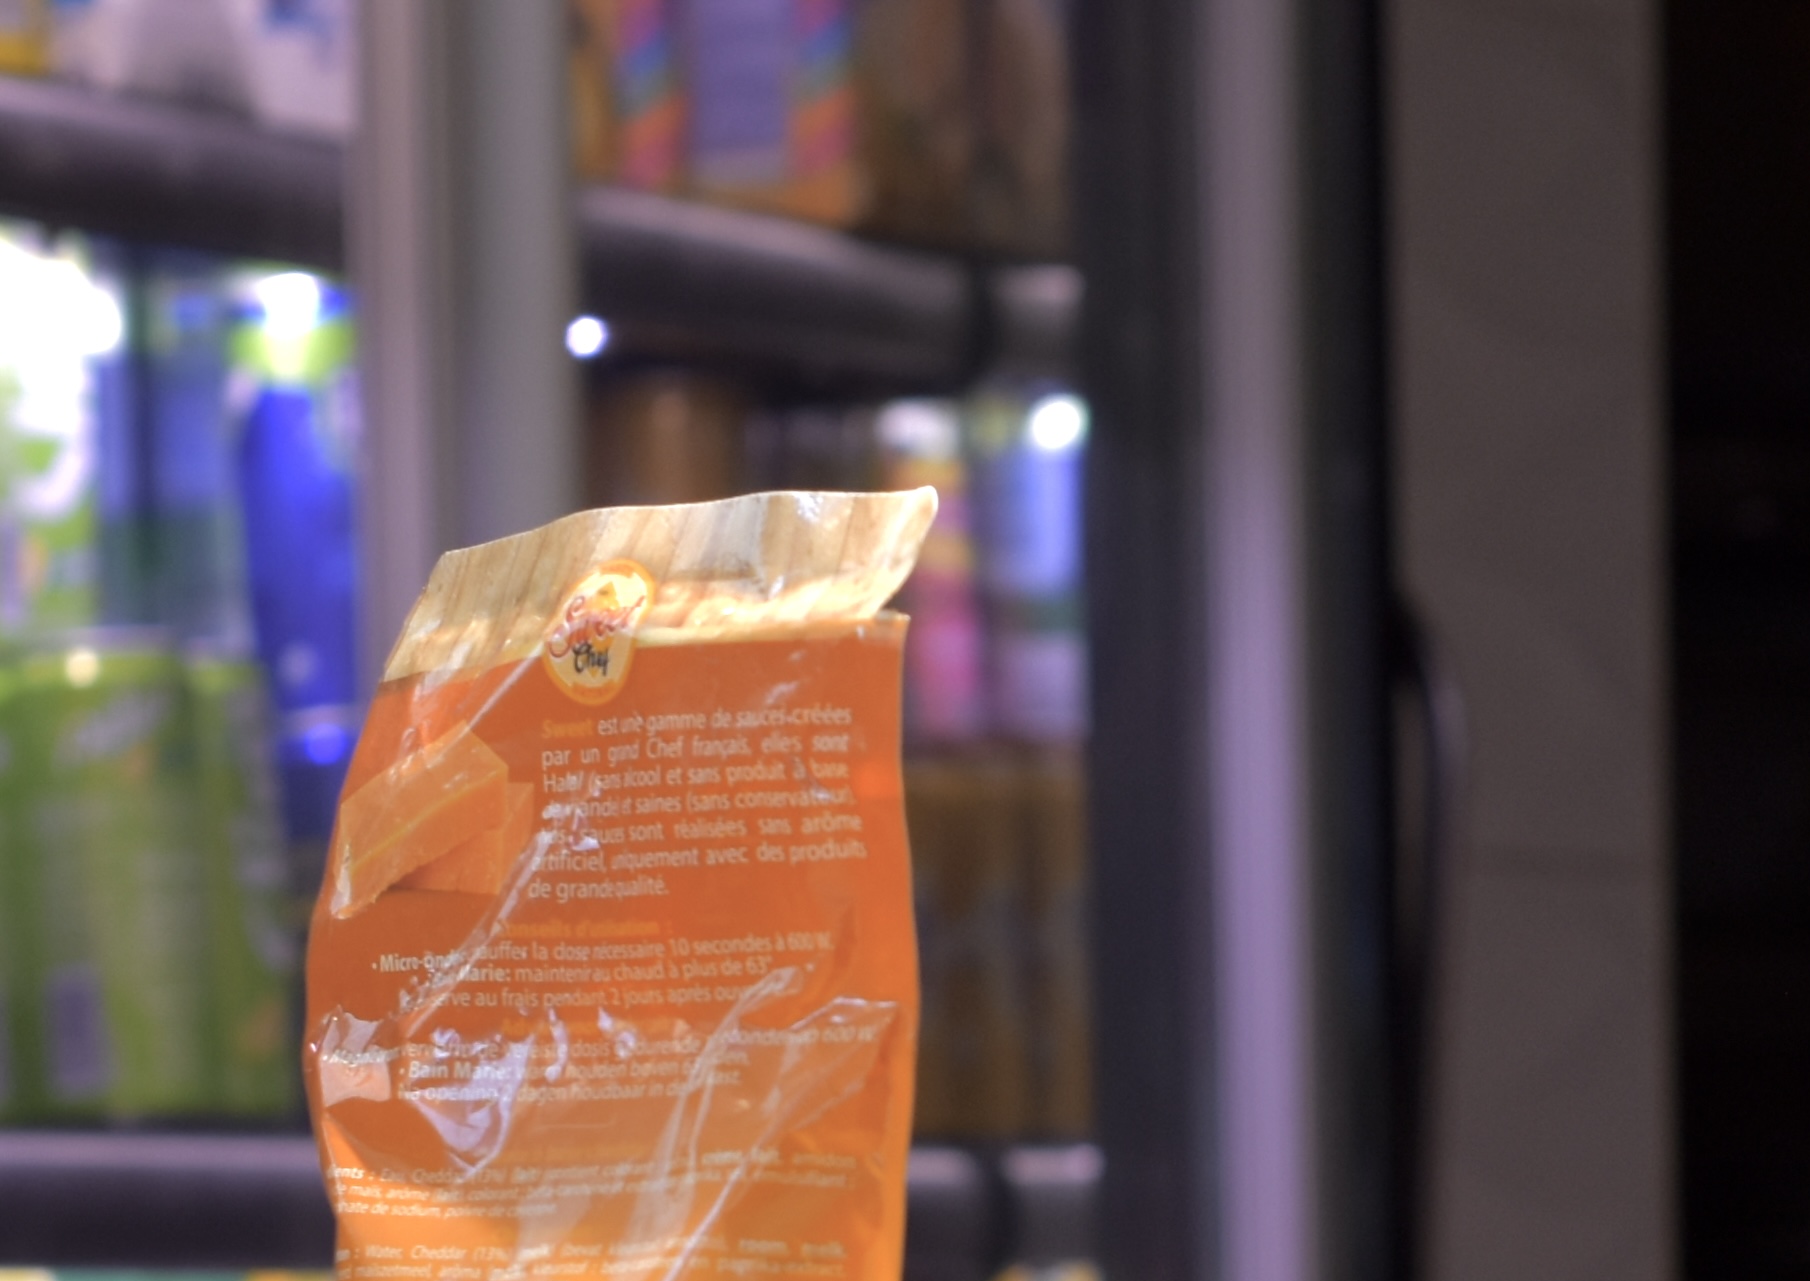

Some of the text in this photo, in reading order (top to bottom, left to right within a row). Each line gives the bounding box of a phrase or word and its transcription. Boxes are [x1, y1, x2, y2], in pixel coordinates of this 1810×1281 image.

[646, 713, 706, 736] gamme
[711, 706, 732, 728] de
[541, 750, 571, 771] par
[580, 748, 600, 764] un
[646, 736, 684, 758] Chef
[812, 734, 849, 752] sont
[666, 766, 682, 785] et
[687, 767, 721, 784] sans
[725, 759, 786, 787] produit
[628, 822, 664, 841] sont
[705, 846, 750, 867] avec
[756, 841, 786, 863] des
[789, 838, 868, 868] produits
[528, 876, 551, 898] de
[531, 940, 549, 960] la
[553, 940, 591, 960] dose
[667, 937, 690, 957] 10
[692, 932, 774, 956] secondes
[613, 960, 665, 982] chaud
[682, 958, 717, 982] plus
[720, 957, 744, 976] de
[474, 990, 498, 1007] au
[501, 986, 540, 1008] frais
